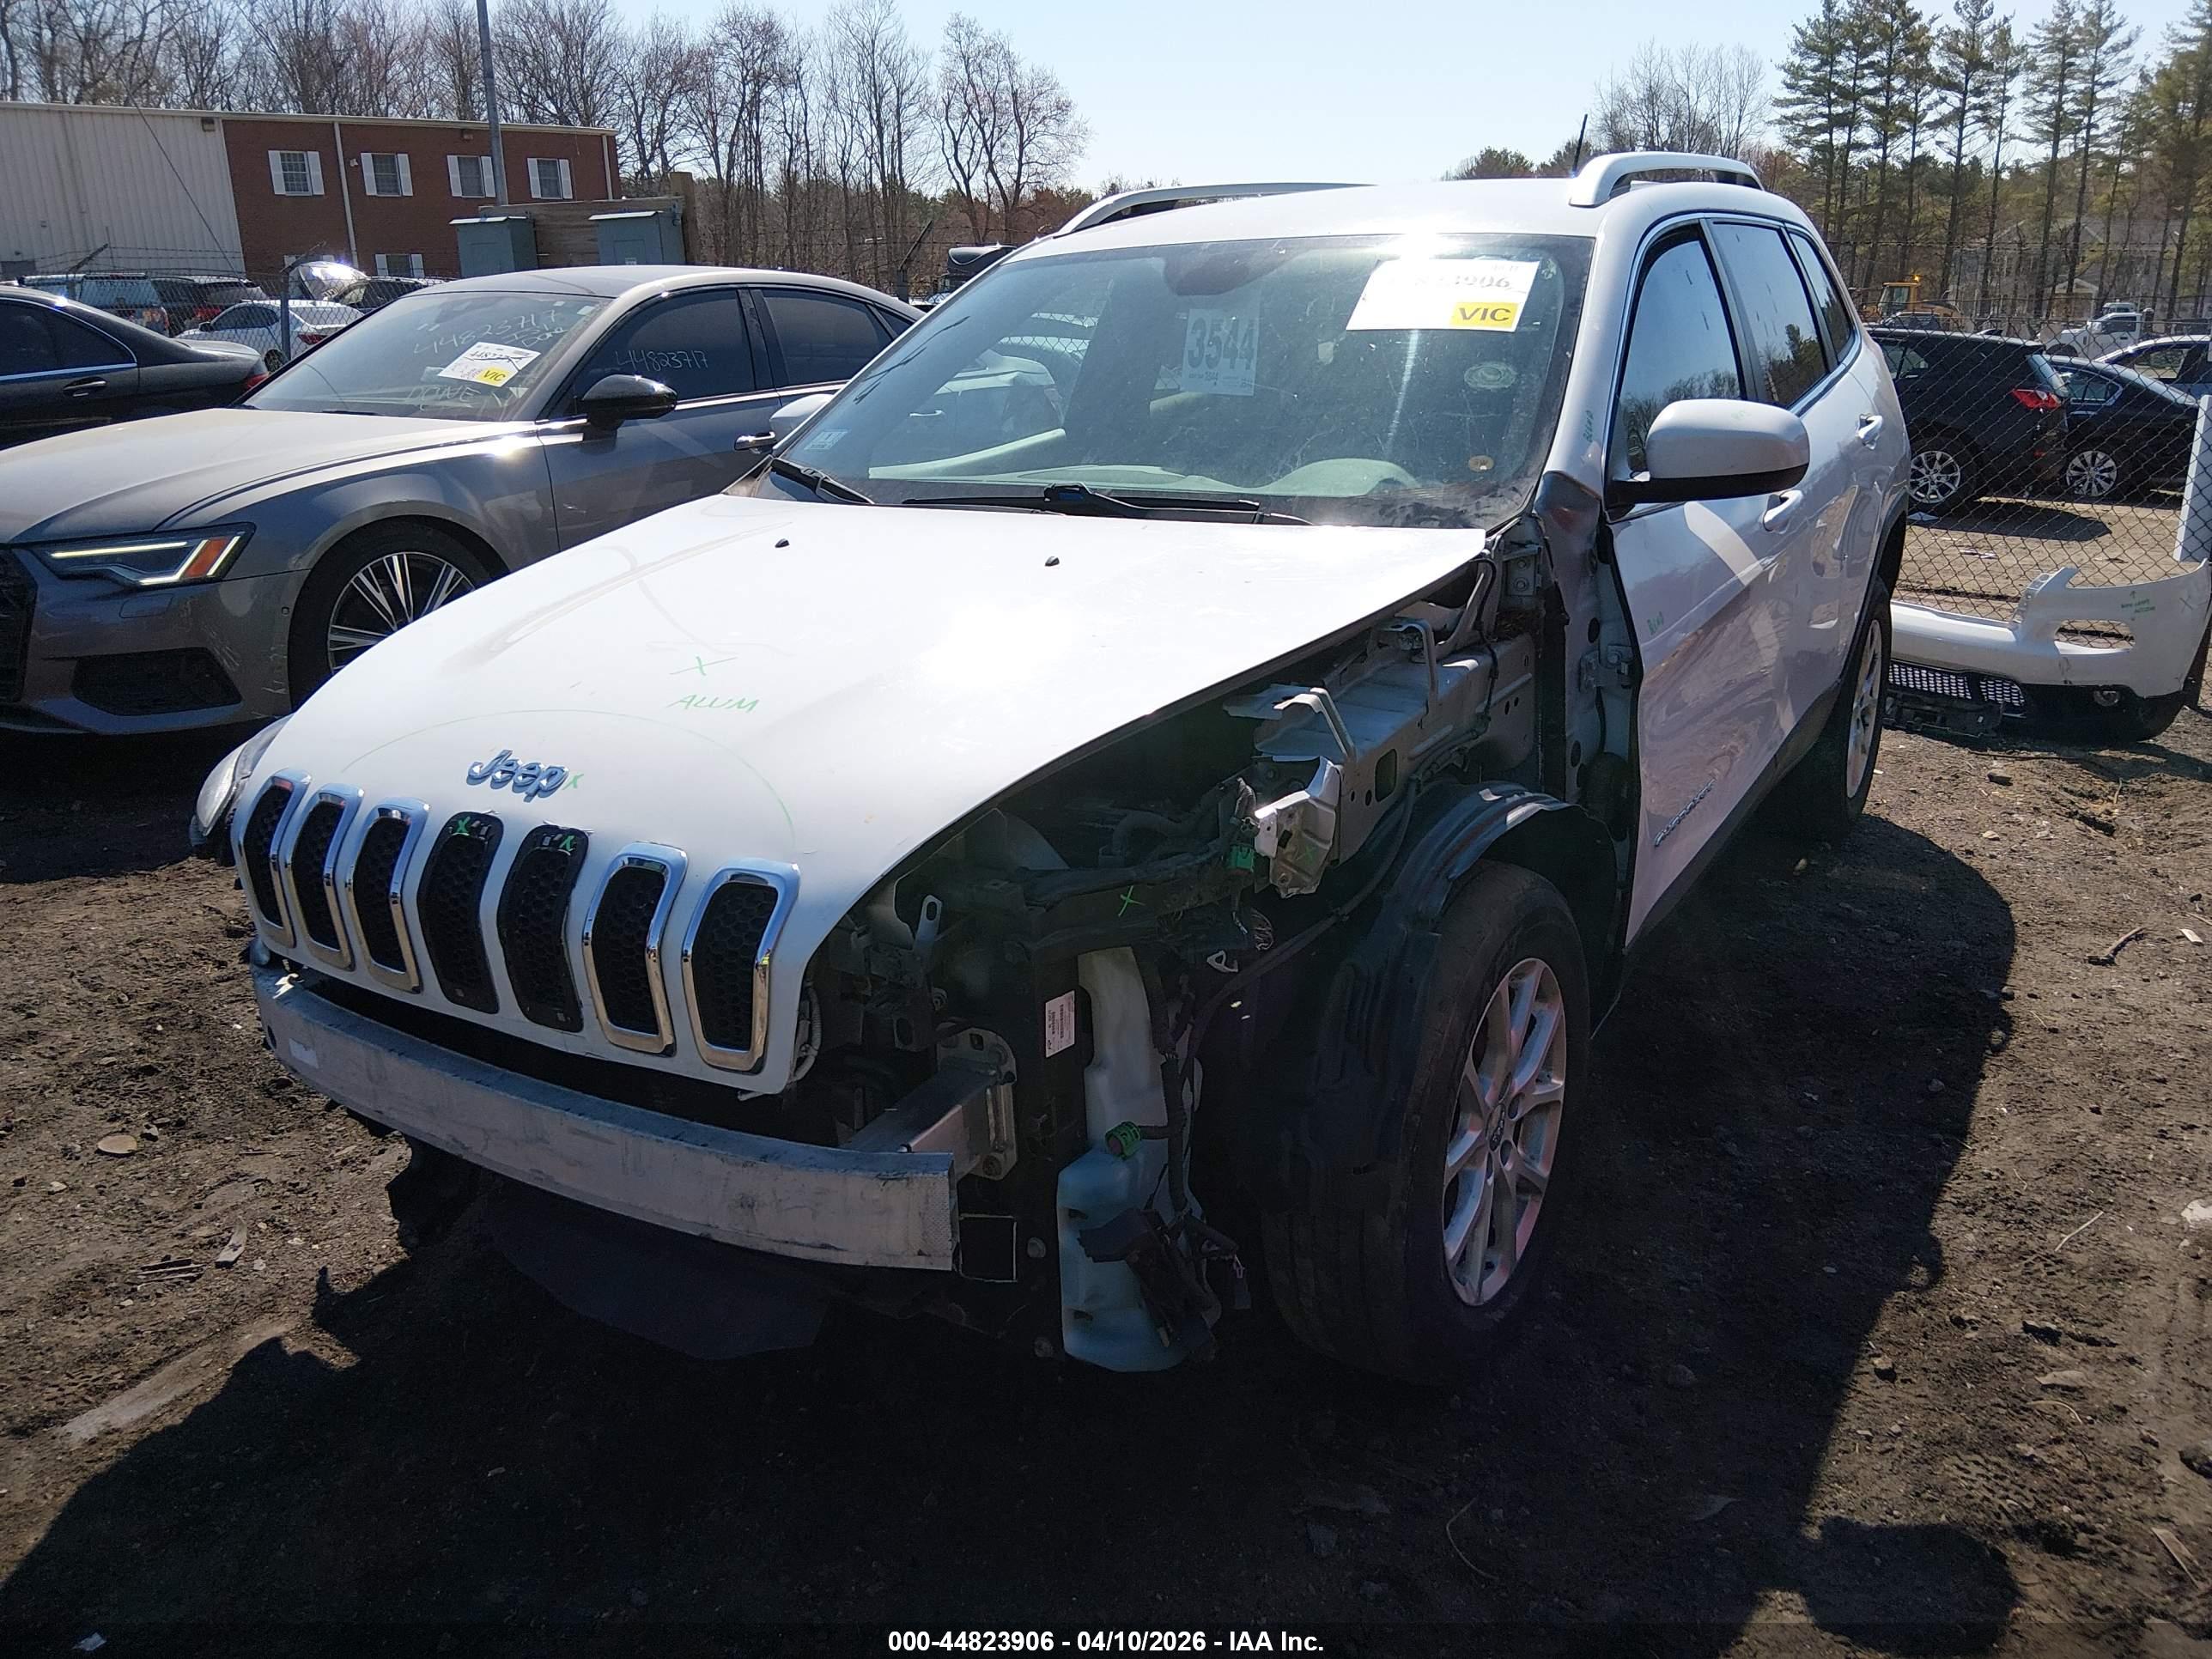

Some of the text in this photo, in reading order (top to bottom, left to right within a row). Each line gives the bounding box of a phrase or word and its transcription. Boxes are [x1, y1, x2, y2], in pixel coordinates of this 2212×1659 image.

[1458, 307, 1512, 323] VIC
[1187, 316, 1256, 371] 3544
[614, 349, 710, 372] 44823717
[483, 369, 507, 382] VIC
[465, 749, 570, 804] Jeep
